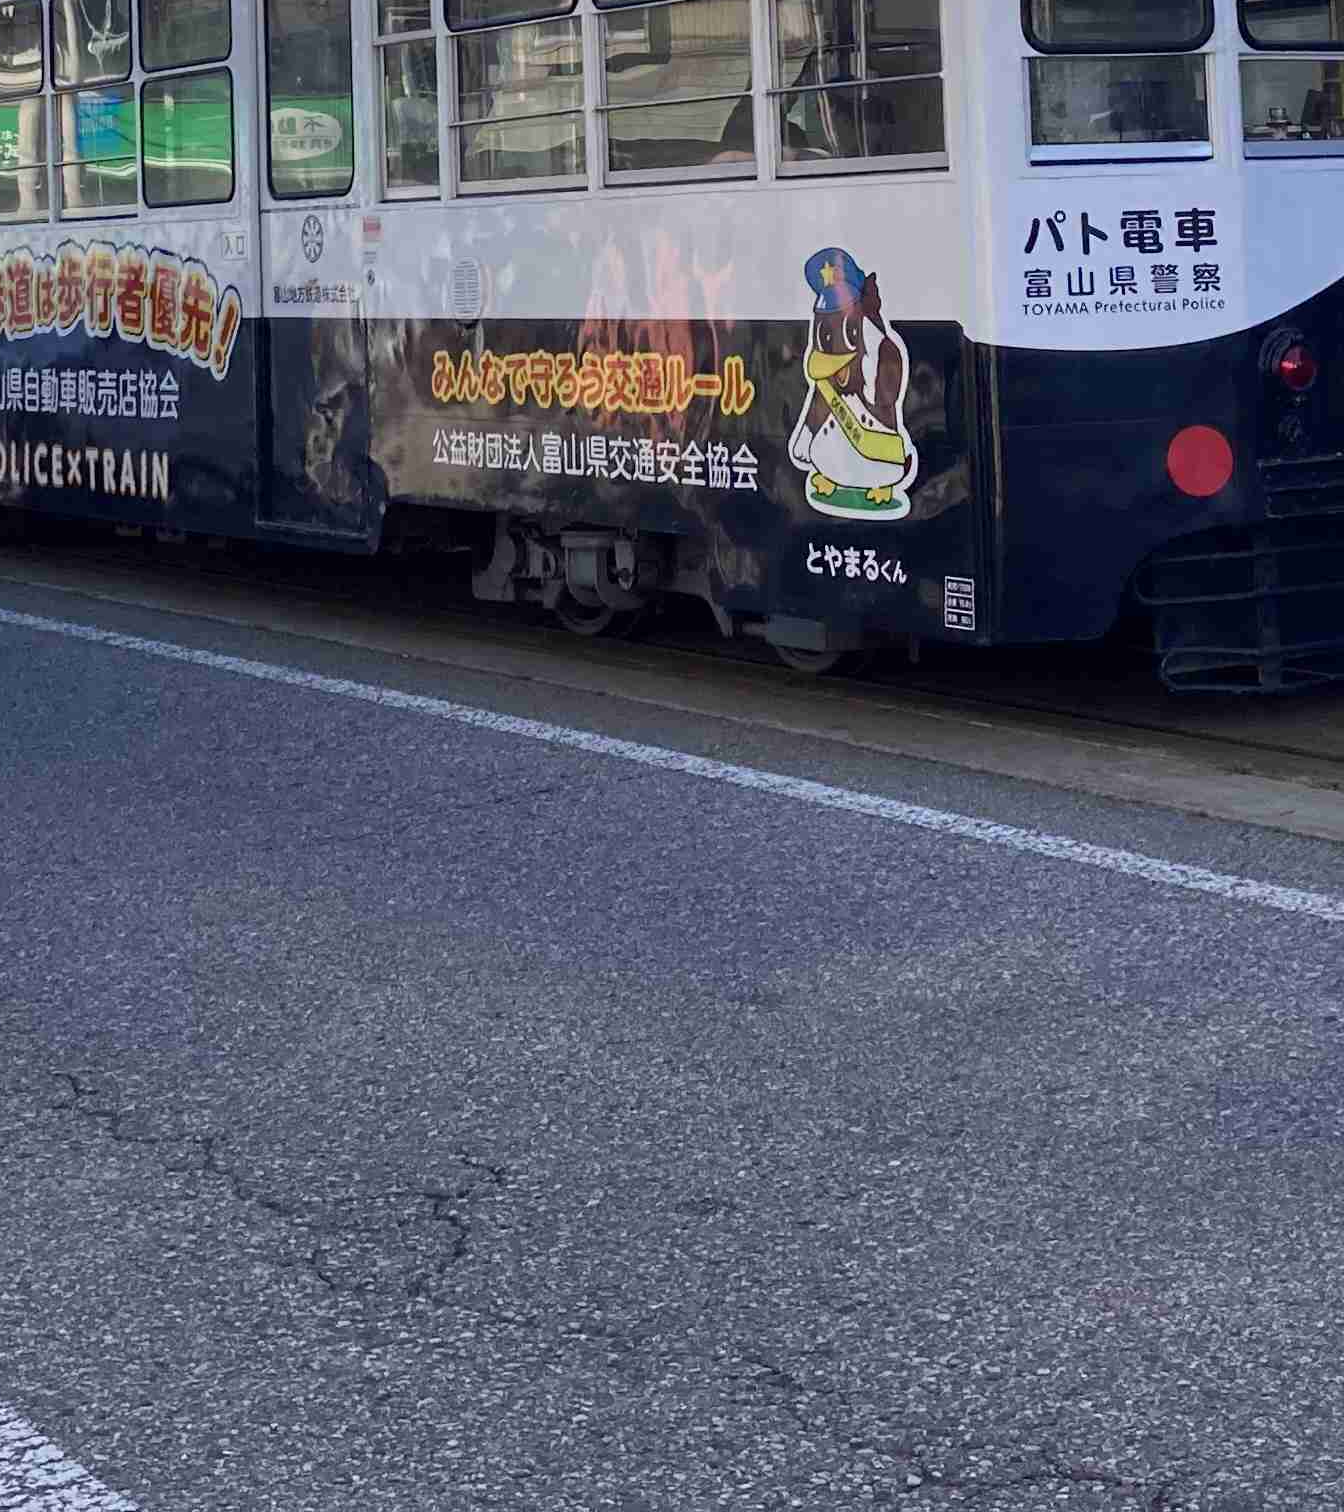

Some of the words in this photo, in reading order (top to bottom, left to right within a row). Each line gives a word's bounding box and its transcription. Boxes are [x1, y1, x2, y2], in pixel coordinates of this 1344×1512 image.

[1023, 207, 1218, 256] パト電車
[1023, 263, 1223, 299] 富山県警察
[1023, 300, 1089, 317] TOYAMA
[1094, 297, 1178, 315] Prefectural
[1182, 296, 1226, 313] Police
[431, 349, 755, 415] みんなで守ろう交通ルール
[432, 427, 758, 492] 公益財団法人富山県交通安全協会
[806, 542, 907, 585] とやまるくん
